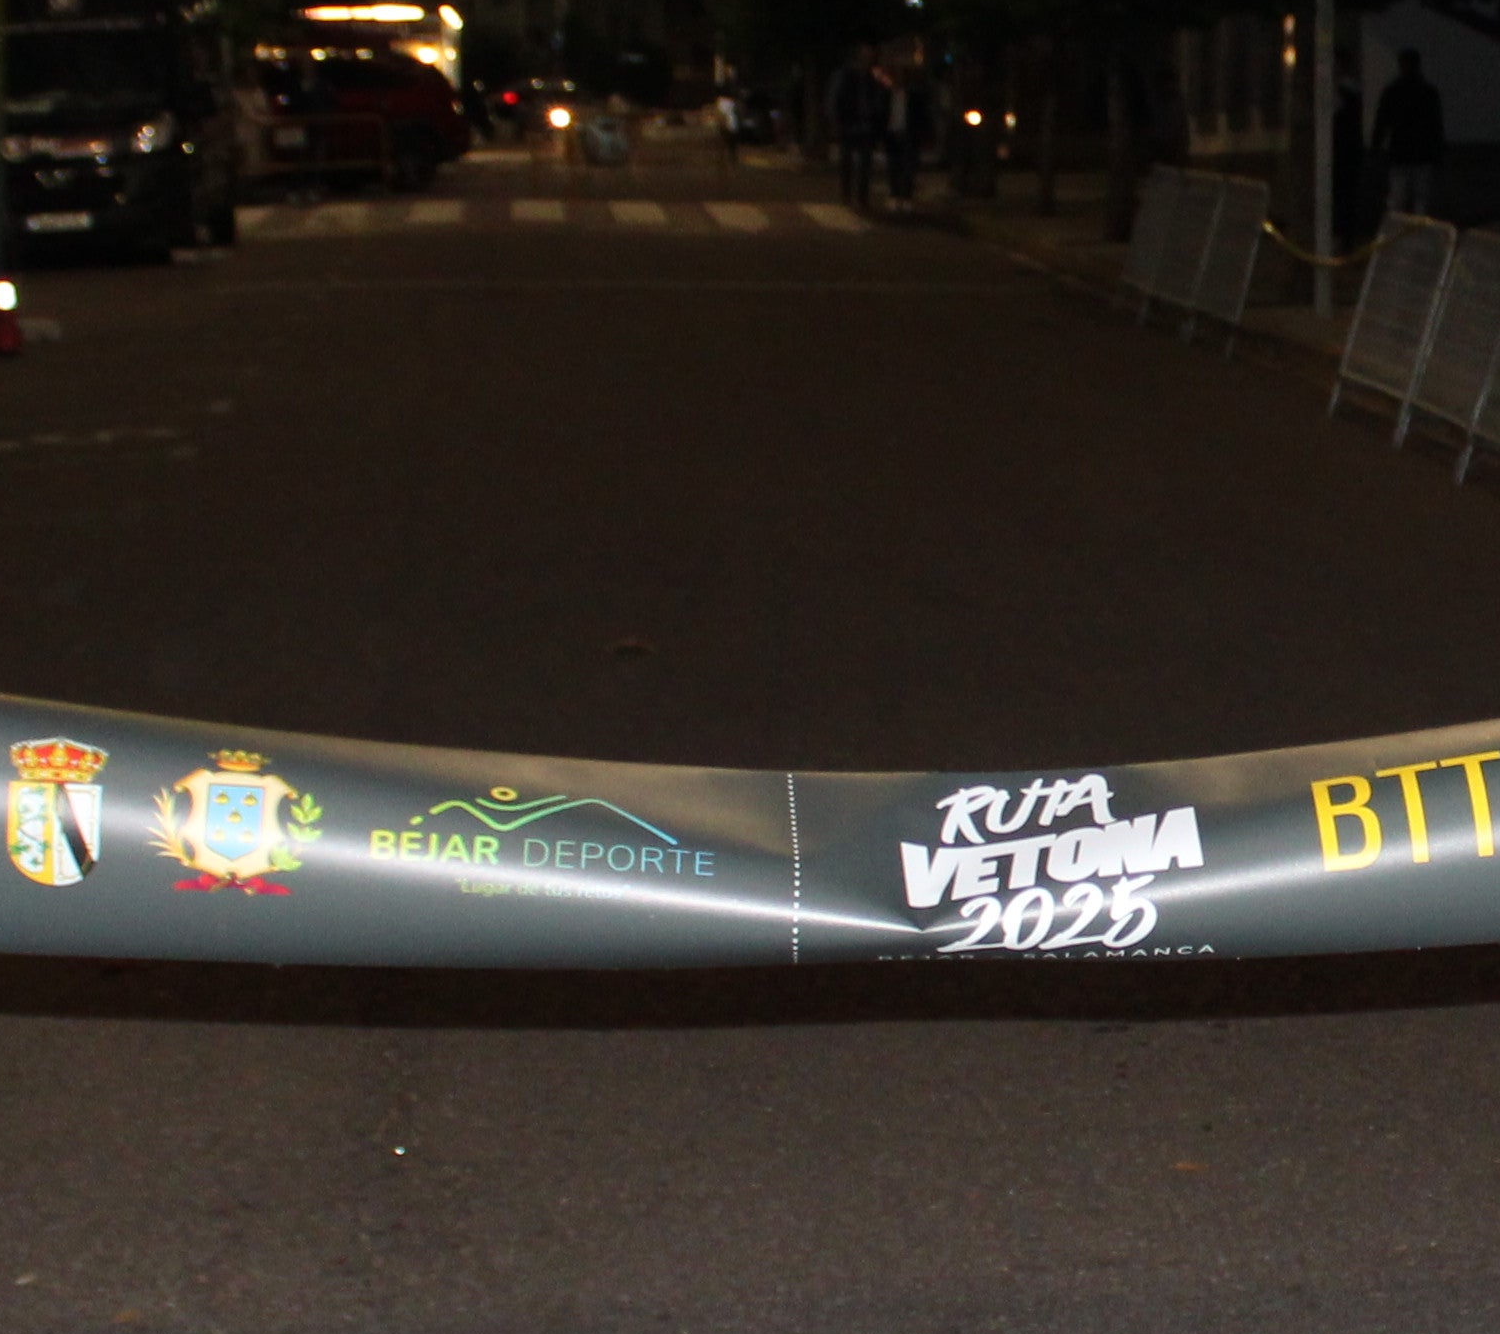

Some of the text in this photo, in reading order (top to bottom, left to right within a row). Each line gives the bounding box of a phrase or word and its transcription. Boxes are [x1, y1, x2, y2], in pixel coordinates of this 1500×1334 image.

[936, 773, 1118, 844] RUTA
[523, 837, 715, 876] DEPORTE
[900, 806, 1204, 909] VETONA
[937, 874, 1158, 953] 2025
